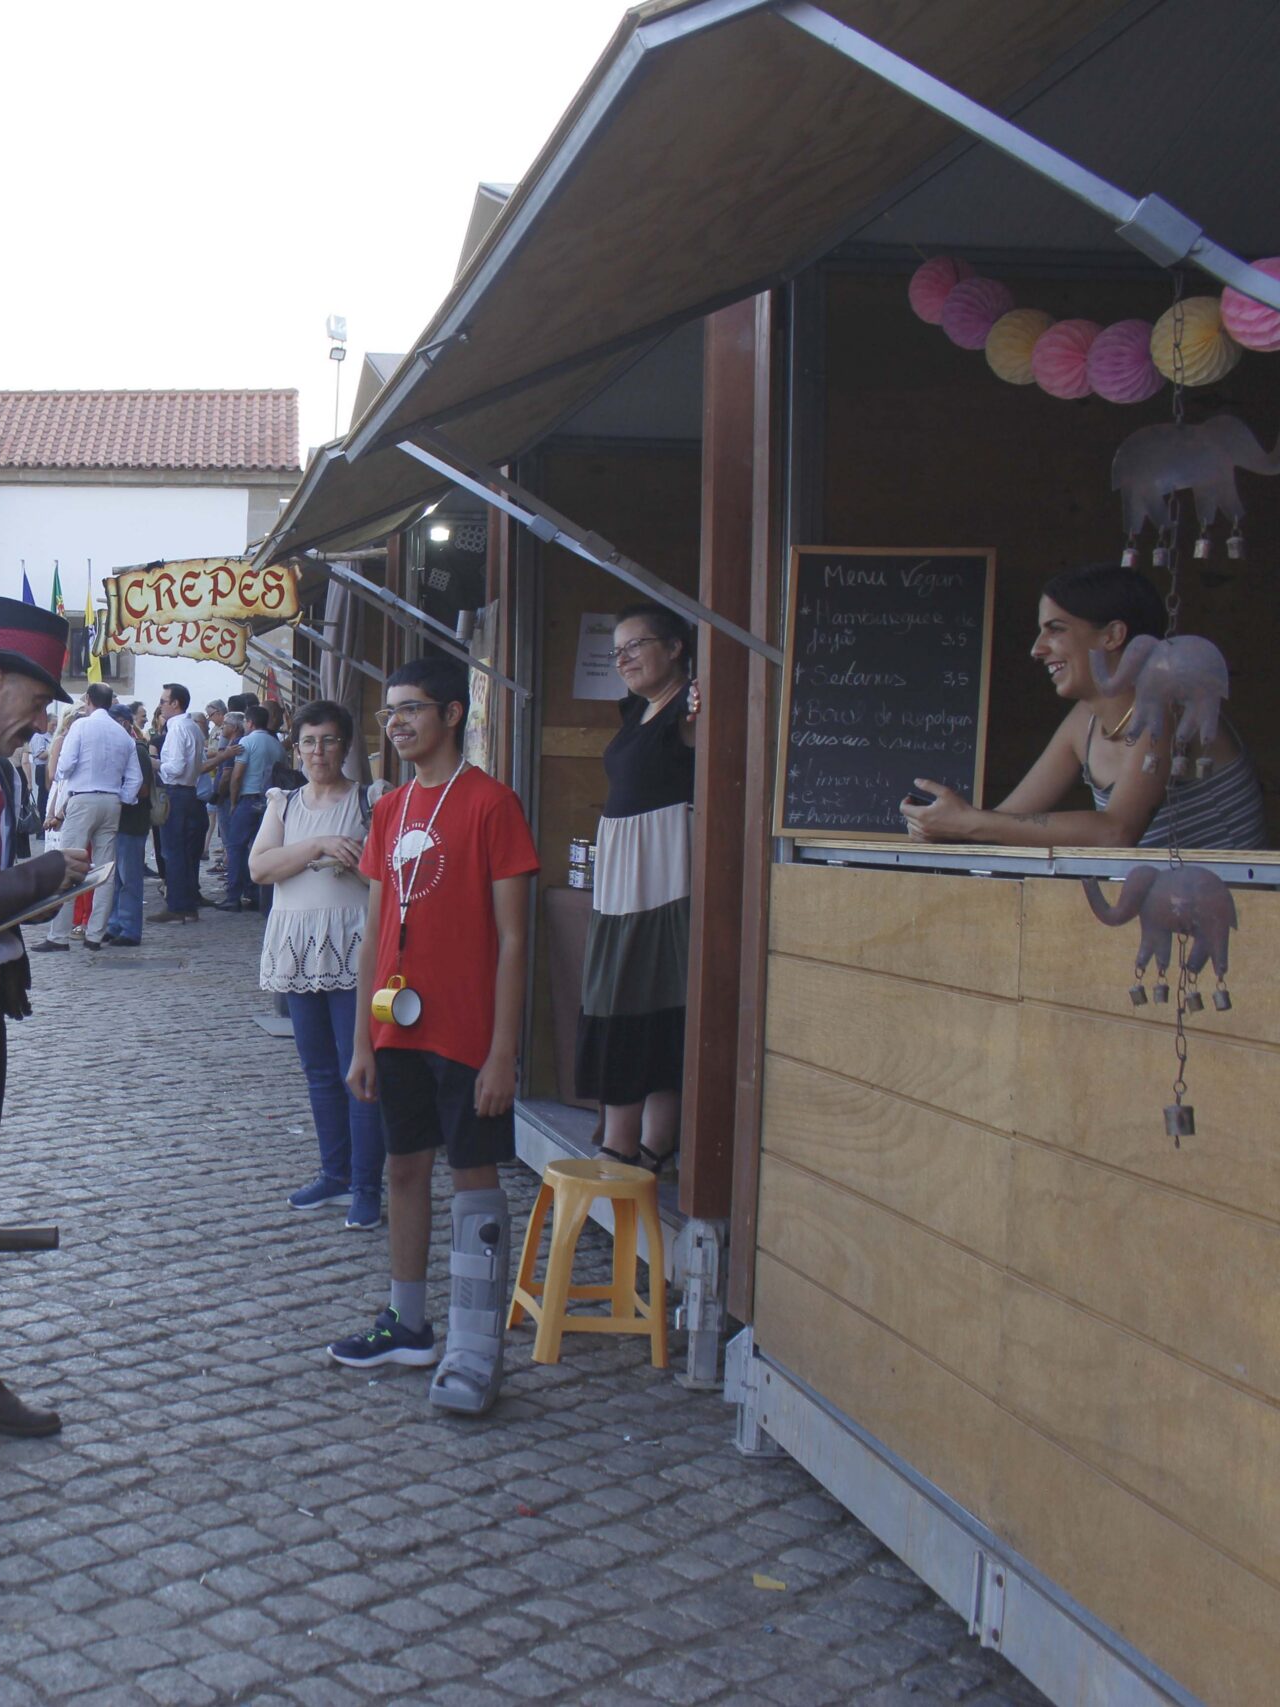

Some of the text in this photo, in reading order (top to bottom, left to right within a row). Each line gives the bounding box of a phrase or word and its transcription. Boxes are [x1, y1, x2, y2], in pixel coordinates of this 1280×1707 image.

[124, 565, 285, 620] CREPES
[824, 559, 964, 598] Menu Vegan
[943, 671, 969, 687] 3,5
